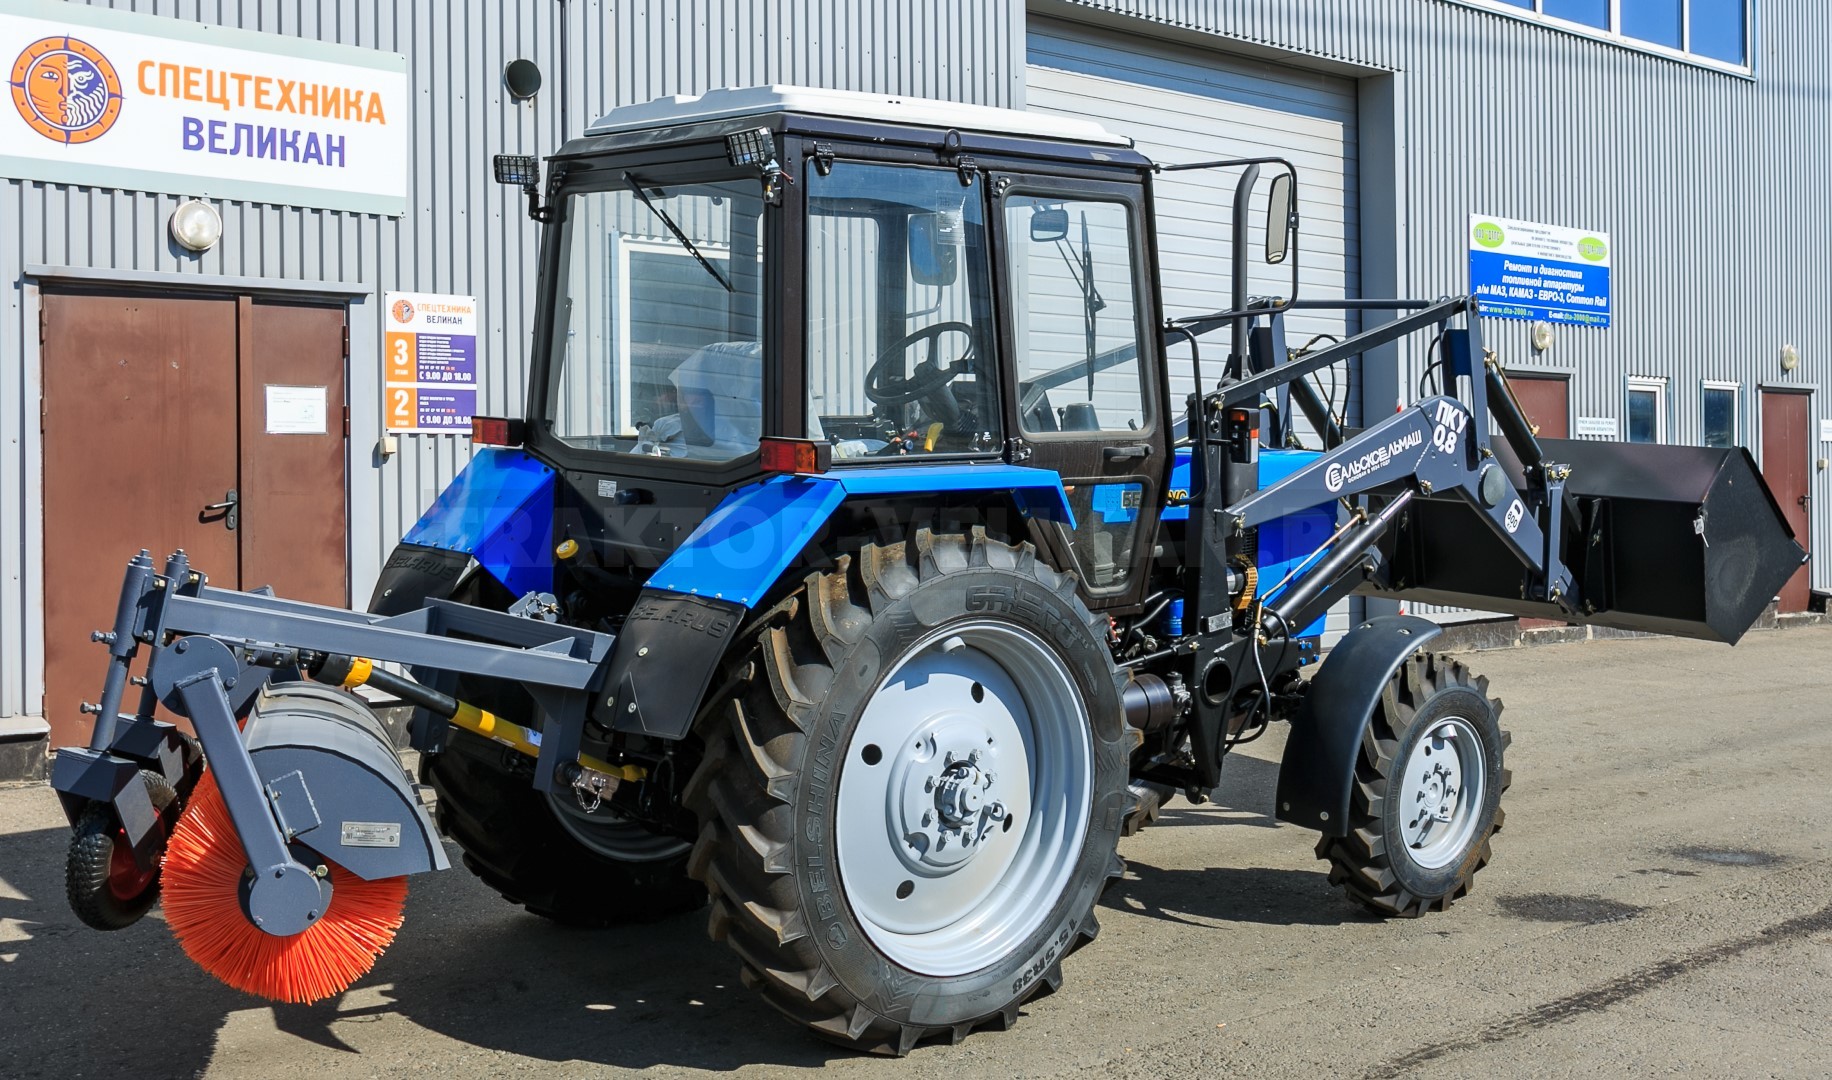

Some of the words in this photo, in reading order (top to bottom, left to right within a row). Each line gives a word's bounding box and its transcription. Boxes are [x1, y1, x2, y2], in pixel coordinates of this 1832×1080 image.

[137, 60, 386, 125] СПЕЦТЕХНИКА
[182, 116, 345, 168] ВЕЛИКАН
[1503, 260, 1532, 274] Ремонт
[1533, 266, 1538, 274] и
[1539, 264, 1583, 279] диагностика
[1490, 285, 1508, 298] МАЗ,
[1509, 287, 1534, 299] КАМАЗ
[1566, 293, 1594, 306] Common
[1594, 296, 1607, 307] Rail
[1502, 275, 1542, 287] топливной
[1543, 280, 1585, 293] аппаратуры
[417, 303, 471, 314] СПЕЦТЕХНИКА
[426, 315, 462, 325] ВЕЛИКАН
[394, 339, 408, 365] 3
[419, 371, 424, 379] С
[425, 372, 441, 380] 9.00
[442, 372, 452, 381] ДО
[454, 373, 472, 381] 18.00
[394, 390, 409, 416] 2
[420, 415, 425, 423] С
[426, 415, 441, 424] 9.00
[442, 416, 452, 425] ДО
[454, 416, 472, 425] 18.00
[1435, 399, 1469, 434] ПКУ
[1433, 424, 1457, 454] 0,8
[1507, 511, 1518, 528] 800
[386, 556, 459, 580] BELARUS
[630, 604, 731, 638] BELARUS
[805, 710, 848, 921] BELSHINA
[1013, 918, 1078, 995] 15.5R38
